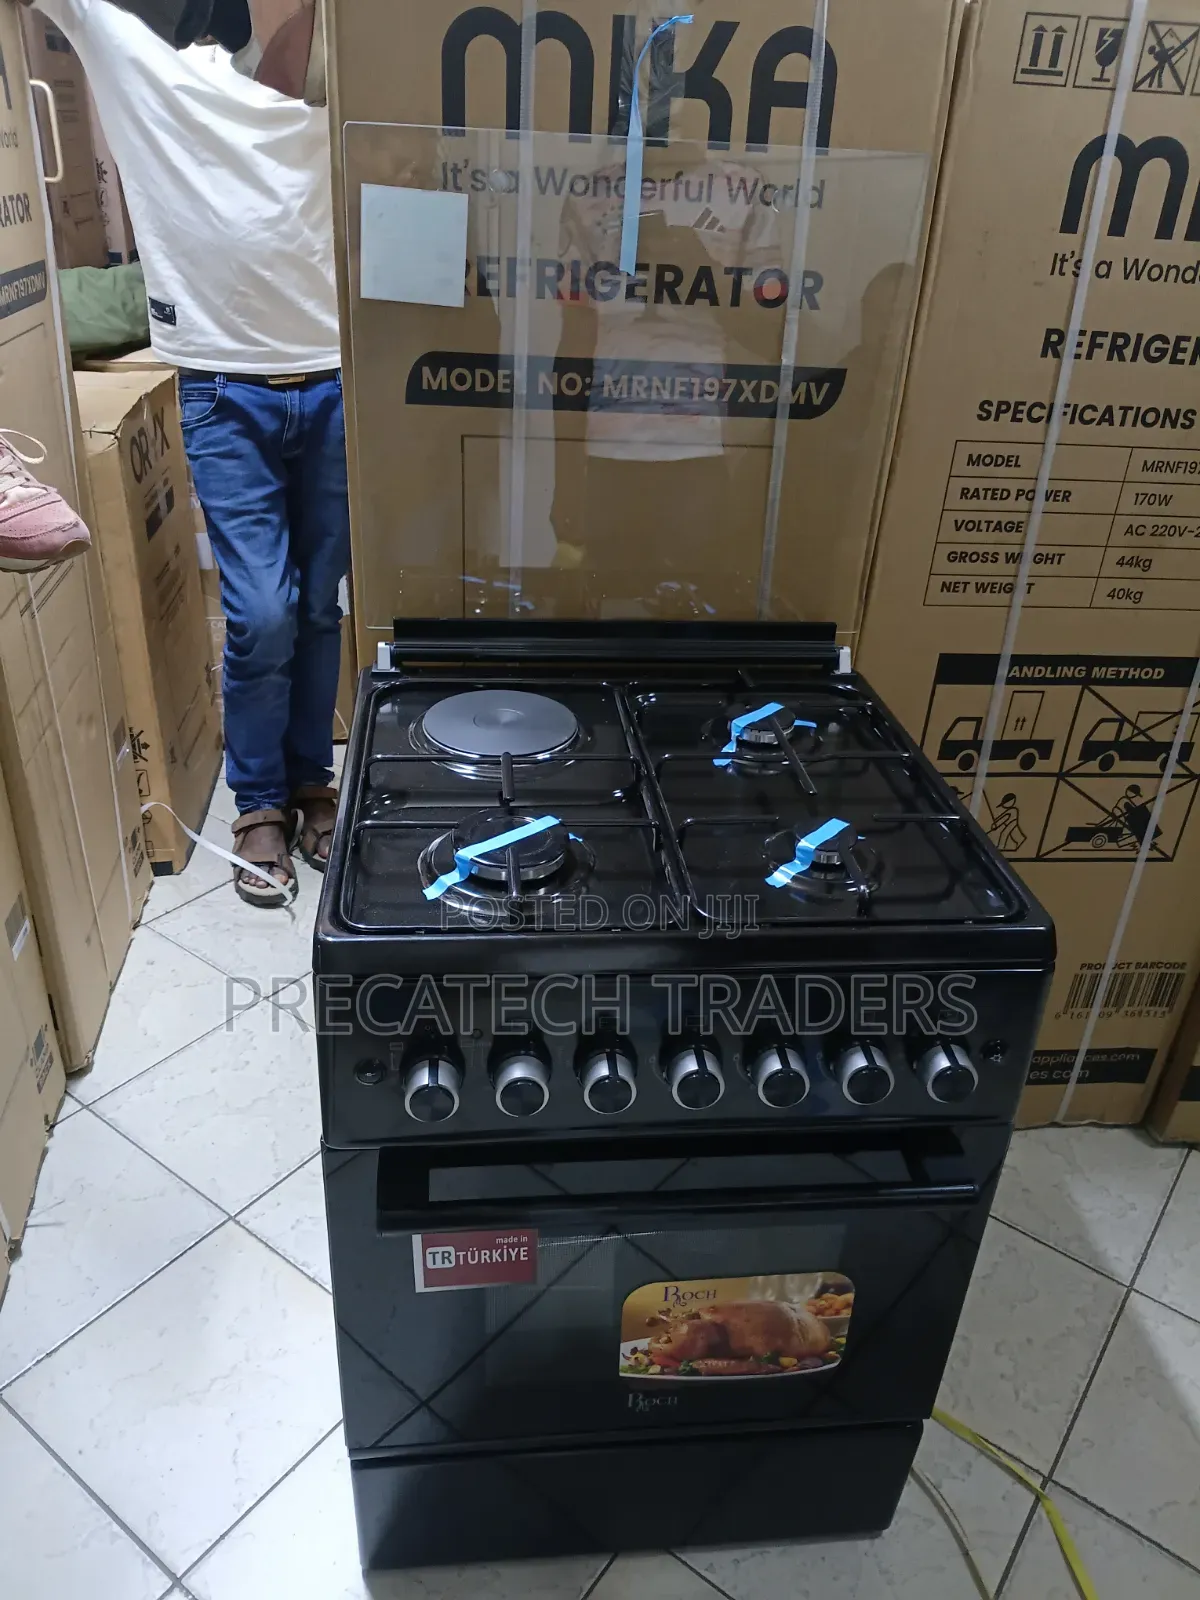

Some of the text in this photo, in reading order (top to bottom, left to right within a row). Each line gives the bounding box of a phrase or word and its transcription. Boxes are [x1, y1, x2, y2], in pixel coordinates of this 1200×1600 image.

[441, 159, 487, 192] It's
[534, 166, 714, 203] Wonderful
[726, 176, 825, 208] World
[1059, 133, 1200, 242] MI
[1050, 250, 1200, 284] It's a Wond
[464, 256, 824, 311] EFRIGERATOR
[421, 366, 515, 395] MODE
[537, 371, 593, 397] NO:
[966, 453, 1021, 468] MODEL
[1141, 459, 1200, 475] MRNF19
[959, 487, 1011, 501] RATED
[1133, 493, 1174, 506] 170W
[953, 519, 1024, 533] VOLTAGE
[1123, 524, 1147, 536] AC
[947, 551, 1066, 565] GROSS WGHT
[1115, 556, 1152, 573] 44kg
[940, 581, 1035, 594] NET WEIGT
[1106, 588, 1143, 603] 40kg
[1008, 666, 1165, 679] ANDLING METHOD
[1135, 961, 1188, 971] BARCODE
[1070, 1010, 1113, 1020] 16109
[496, 1236, 518, 1244] made
[428, 1245, 529, 1266] TR TÜRKİYE
